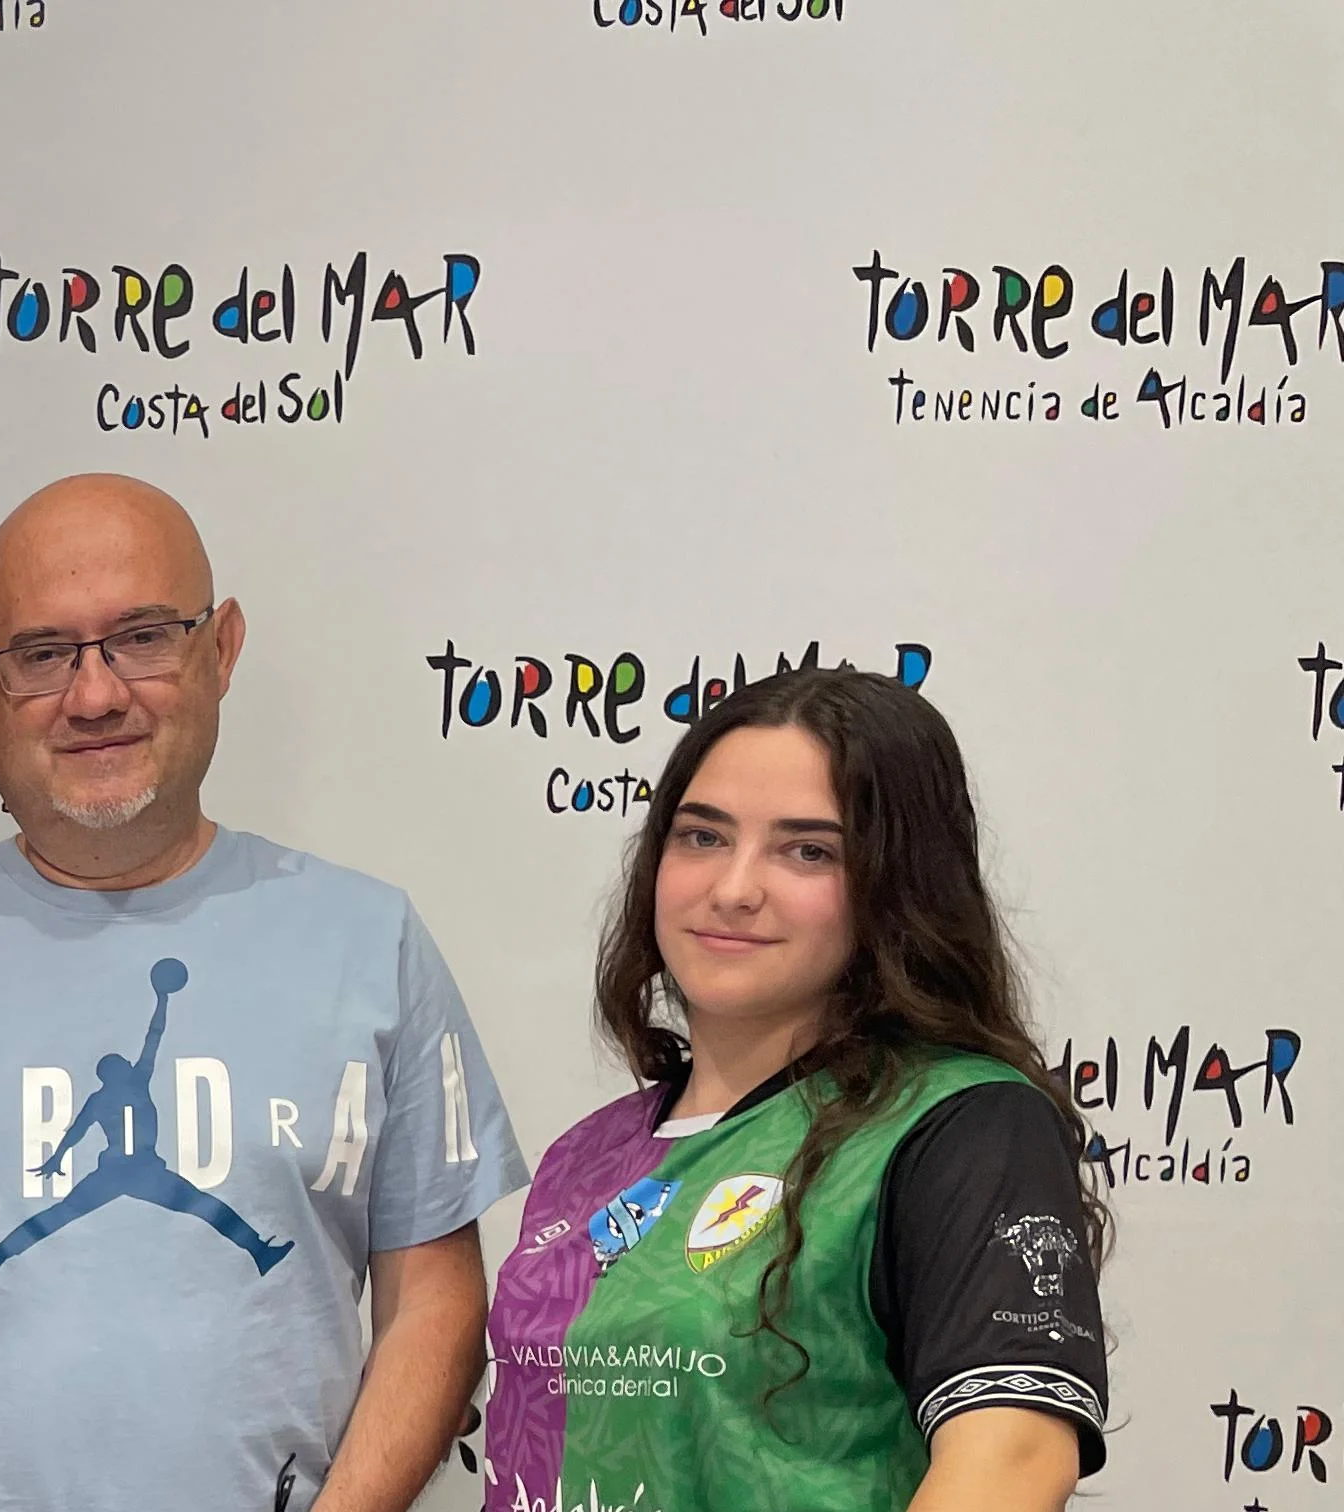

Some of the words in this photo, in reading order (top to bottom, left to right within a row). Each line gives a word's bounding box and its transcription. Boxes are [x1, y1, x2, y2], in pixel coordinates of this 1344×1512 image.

[214, 264, 296, 346] del
[322, 252, 480, 381] MAR
[1091, 268, 1171, 346] del
[97, 381, 211, 438] Costa
[220, 386, 267, 427] del
[279, 371, 344, 425] Sol
[888, 367, 1061, 425] Tenencia
[1081, 382, 1121, 423] de
[1137, 367, 1307, 430] Alcaldía
[1143, 1026, 1302, 1146] MAR
[1082, 1133, 1251, 1189] Alcaldía
[512, 1345, 726, 1377] VALDIVIA&ARMIJO
[612, 1376, 678, 1397] dental
[1210, 1388, 1344, 1484] TOR
